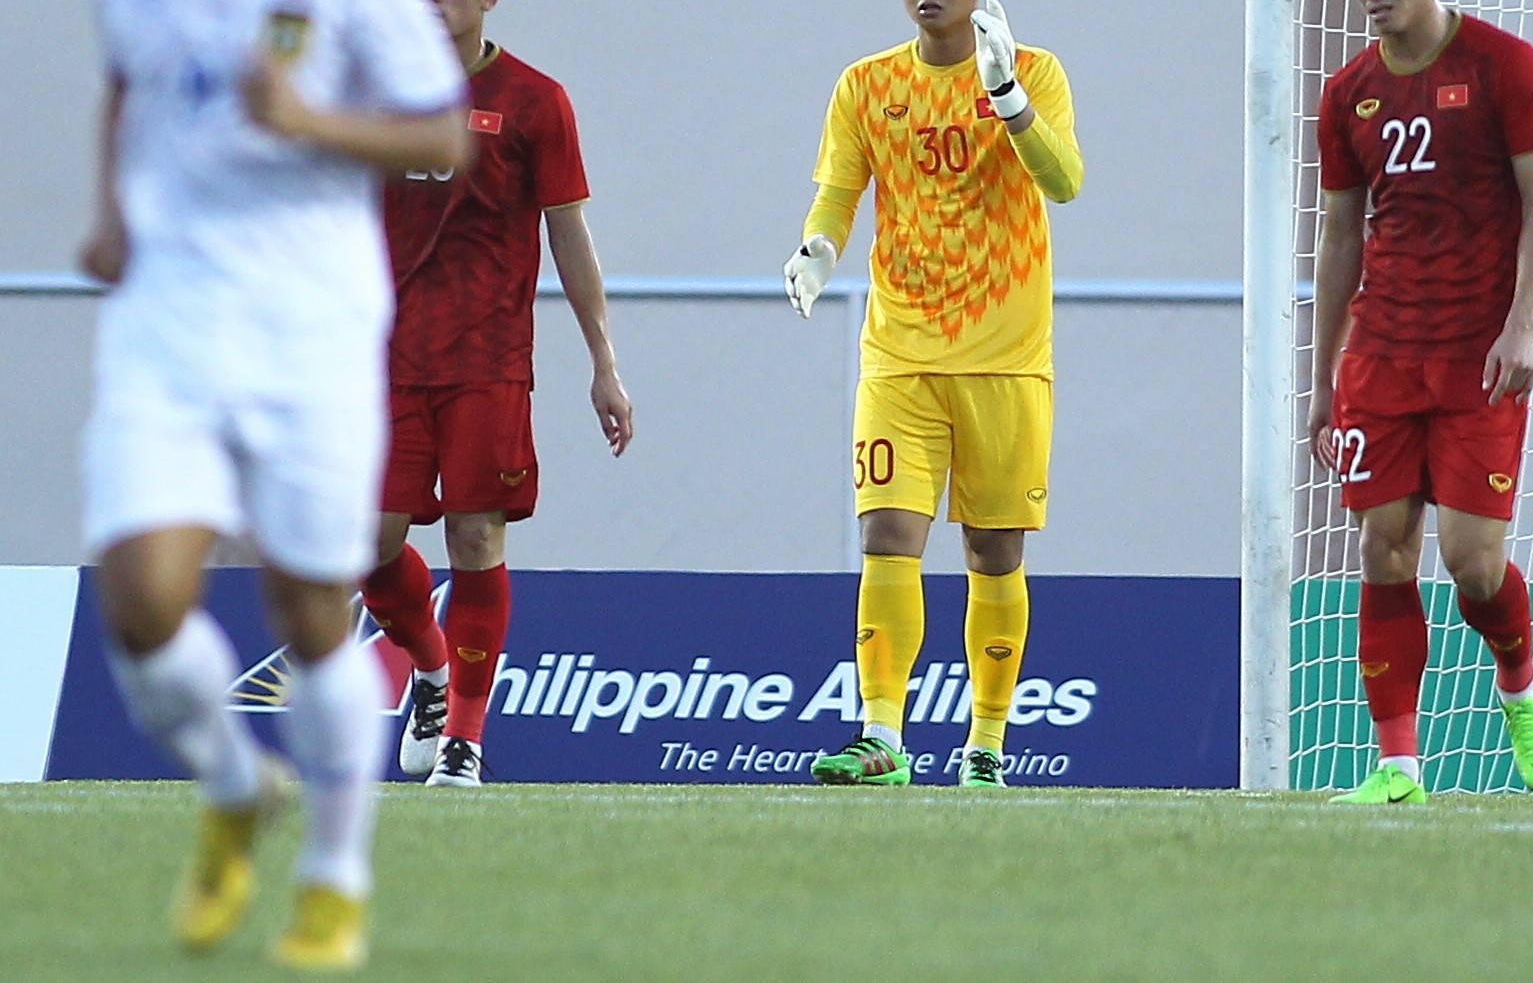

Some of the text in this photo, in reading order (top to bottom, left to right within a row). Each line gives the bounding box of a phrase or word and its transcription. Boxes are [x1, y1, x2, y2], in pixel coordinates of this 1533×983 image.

[916, 125, 970, 175] 30
[1381, 116, 1436, 174] 22
[853, 438, 895, 490] 30
[485, 653, 794, 734] hilippine
[660, 742, 719, 770] The
